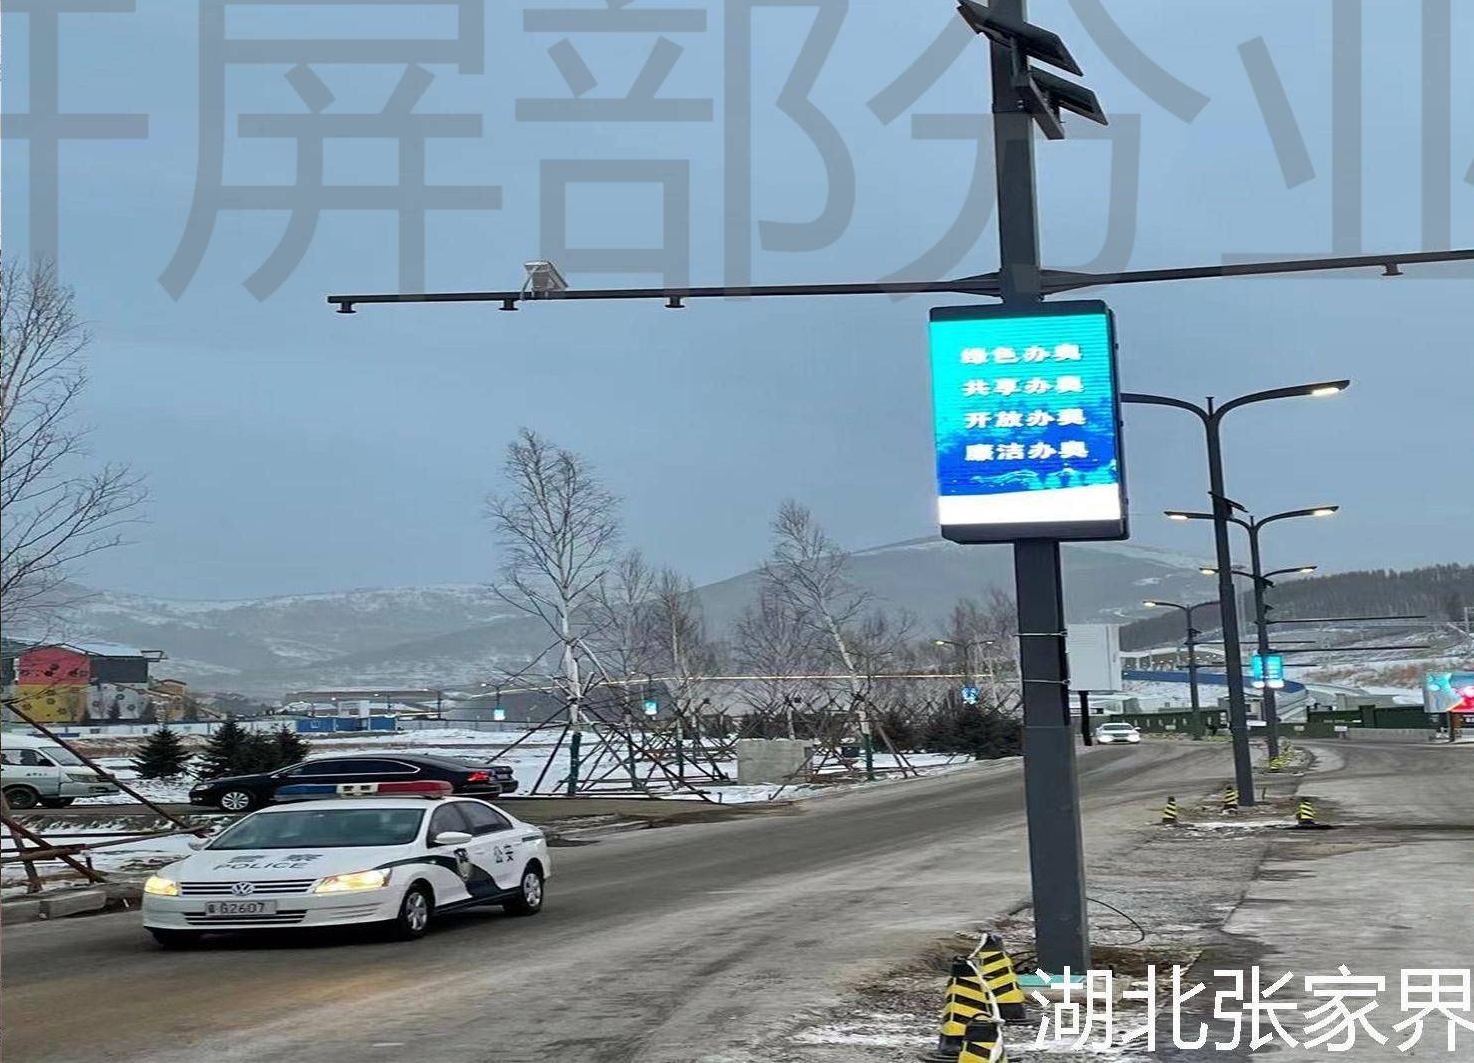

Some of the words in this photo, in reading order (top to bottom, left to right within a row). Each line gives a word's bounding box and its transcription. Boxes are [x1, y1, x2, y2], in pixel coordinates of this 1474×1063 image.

[959, 343, 1082, 365] 绿色办奥
[963, 375, 1085, 397] 共享办奥
[964, 408, 1087, 429] 开放办奥
[494, 844, 514, 864] 公安
[214, 862, 309, 871] POLICE
